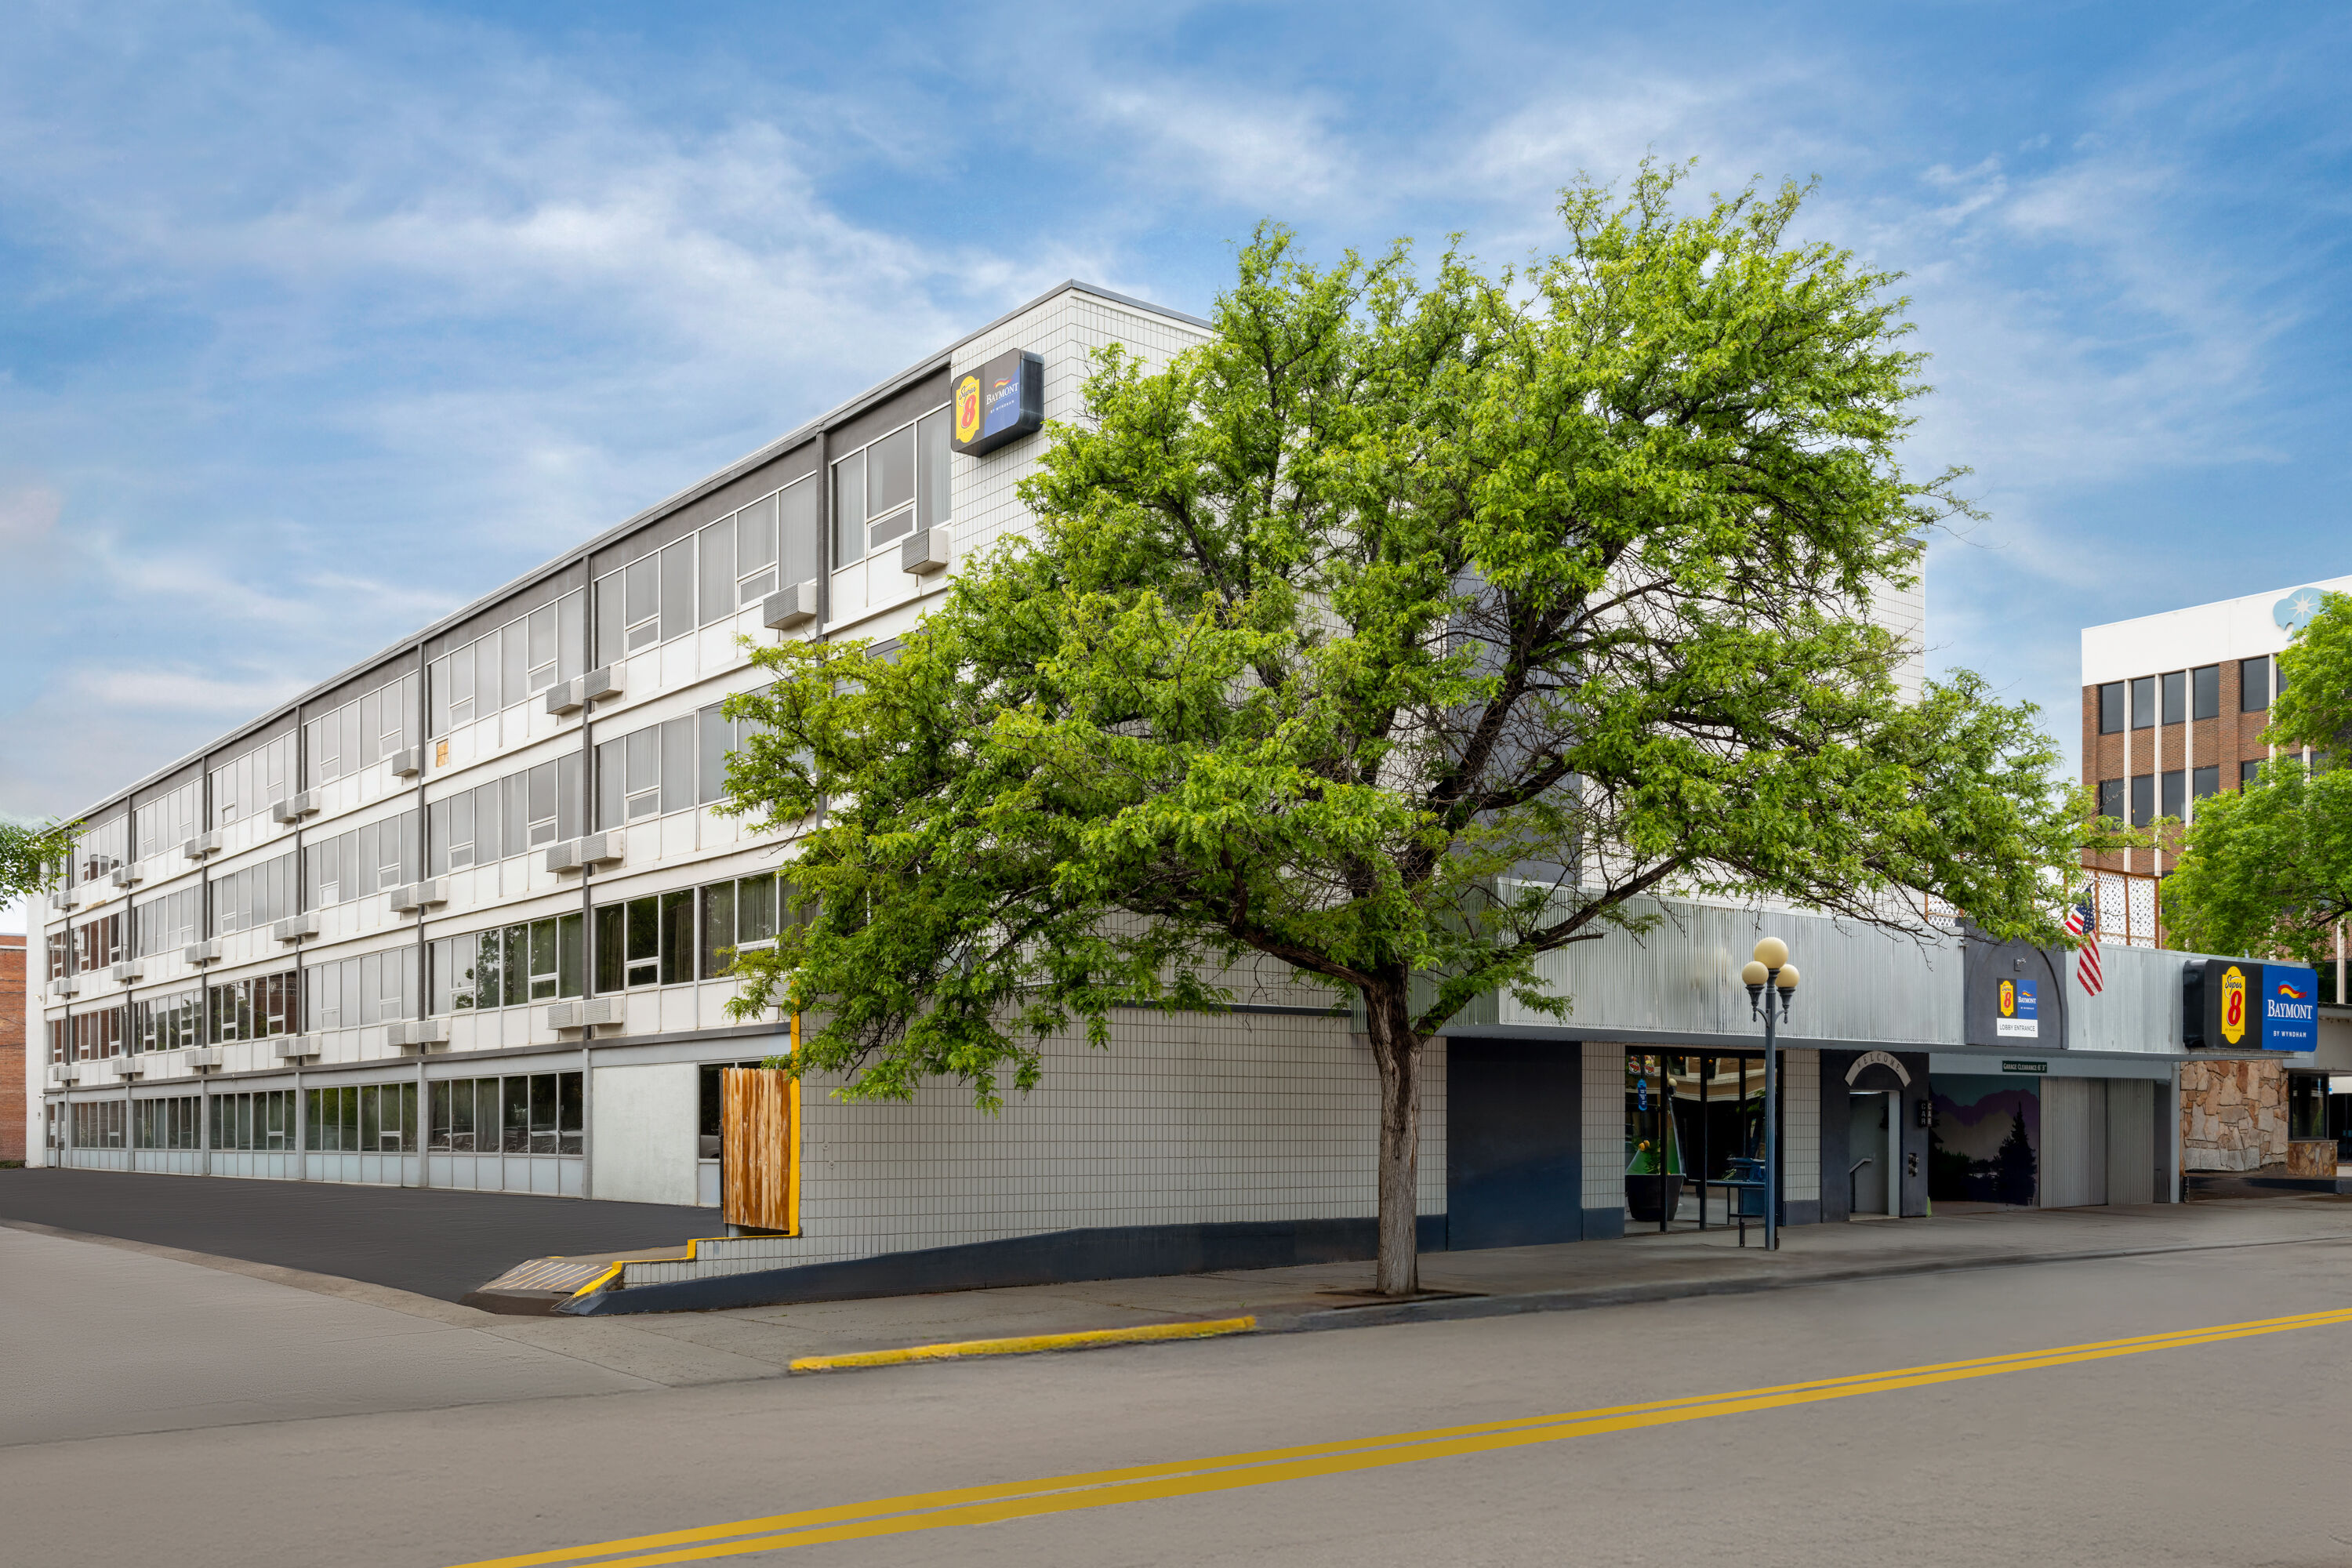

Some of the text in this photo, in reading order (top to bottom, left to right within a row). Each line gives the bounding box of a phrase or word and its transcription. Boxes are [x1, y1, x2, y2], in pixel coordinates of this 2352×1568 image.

[958, 385, 977, 405] Super
[986, 382, 1019, 405] BAYMONT
[961, 394, 977, 429] 8
[2224, 975, 2242, 996] Super
[2004, 992, 2012, 1008] 8
[2227, 990, 2242, 1026] 8
[2267, 999, 2313, 1019] BAYMONT
[1857, 1053, 1901, 1072] WELCOME
